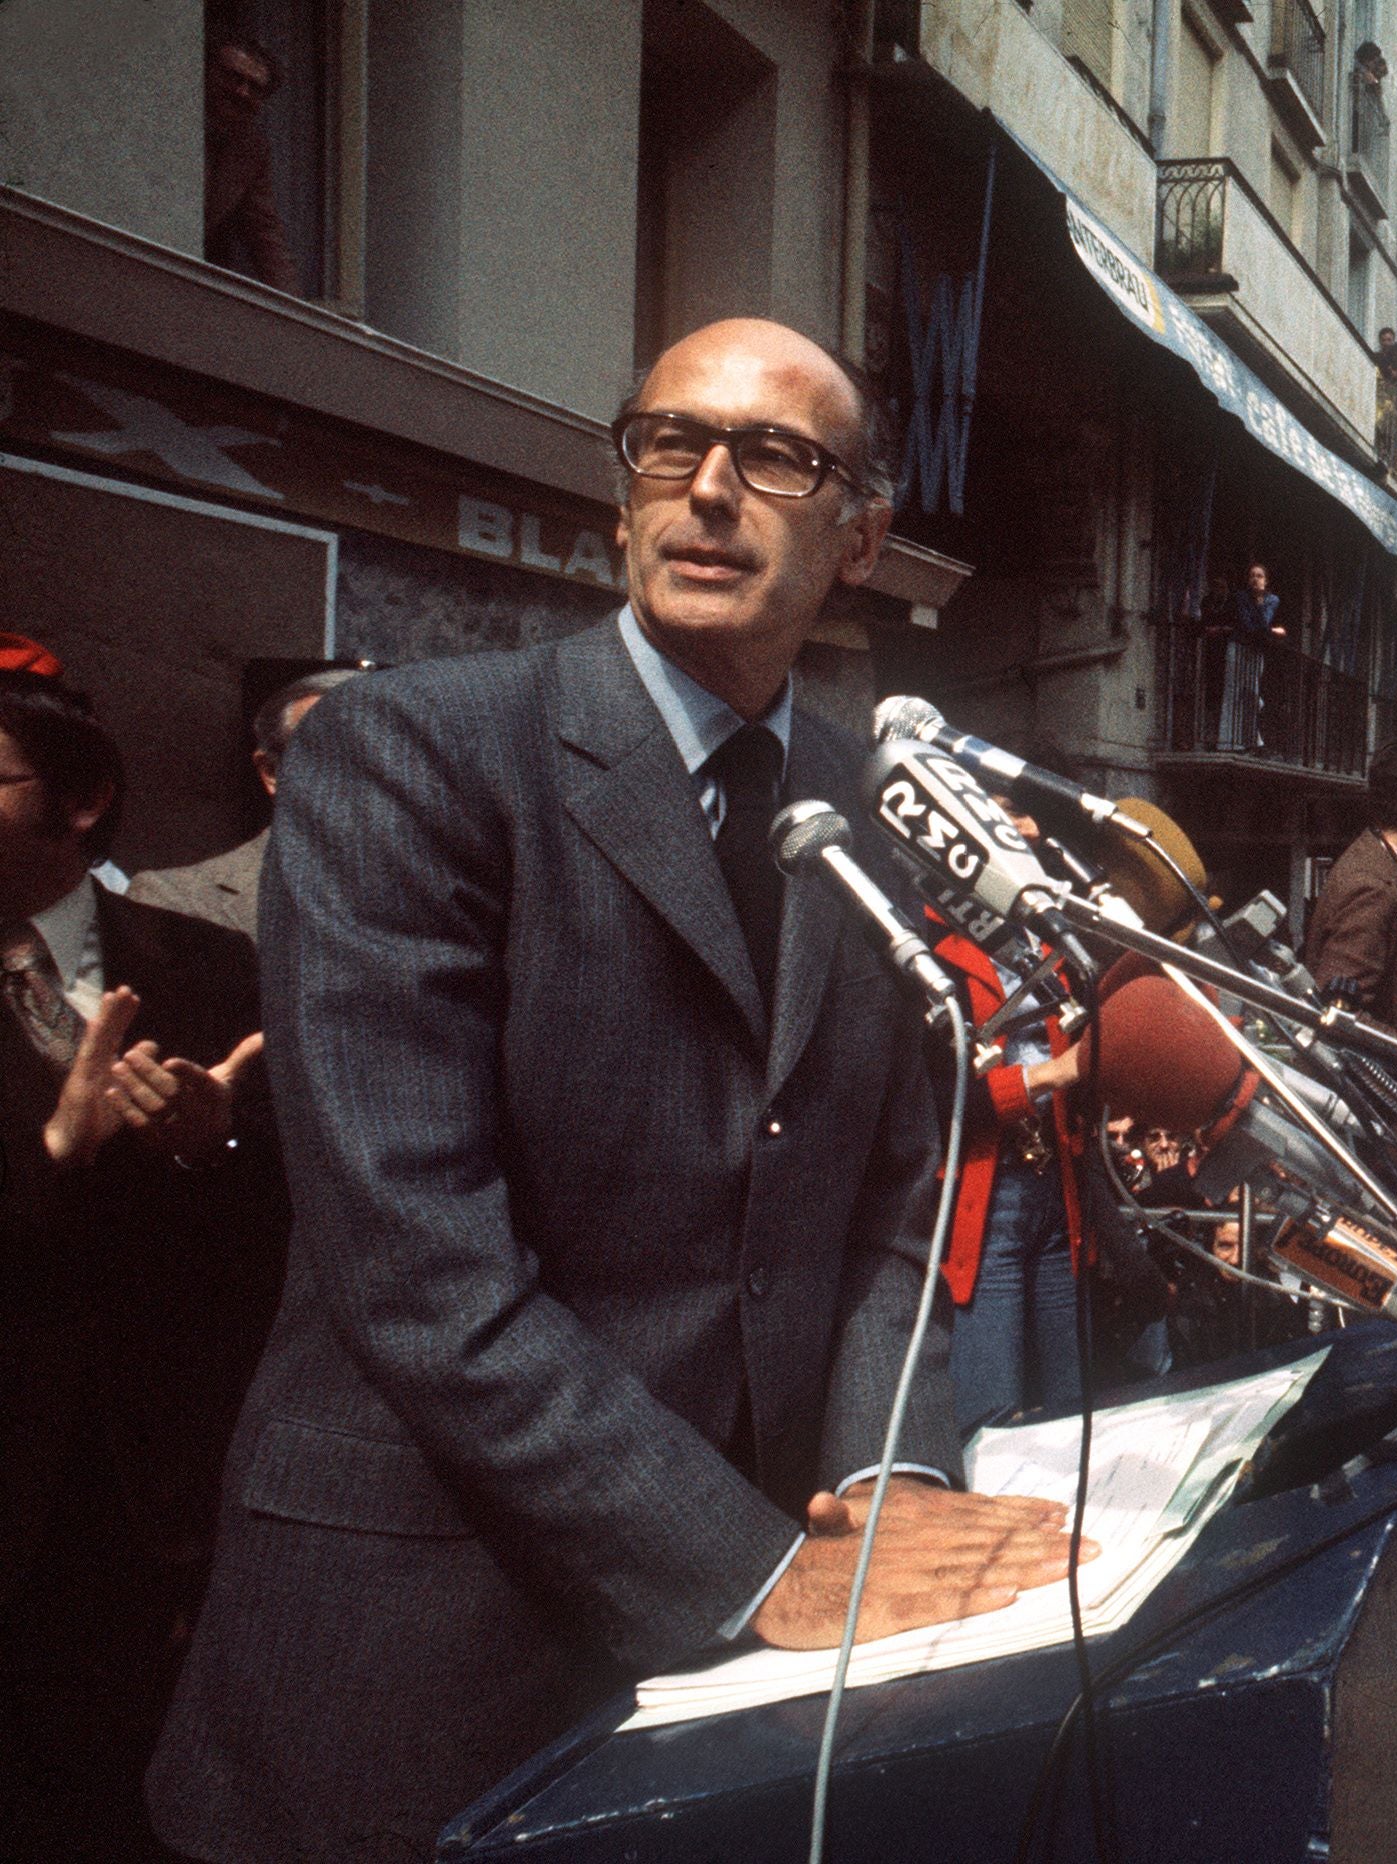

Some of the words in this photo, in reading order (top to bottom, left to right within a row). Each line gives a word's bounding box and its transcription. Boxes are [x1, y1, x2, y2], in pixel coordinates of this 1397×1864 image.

[458, 494, 629, 591] BLA
[879, 780, 980, 879] RMC
[926, 757, 1027, 851] RMC
